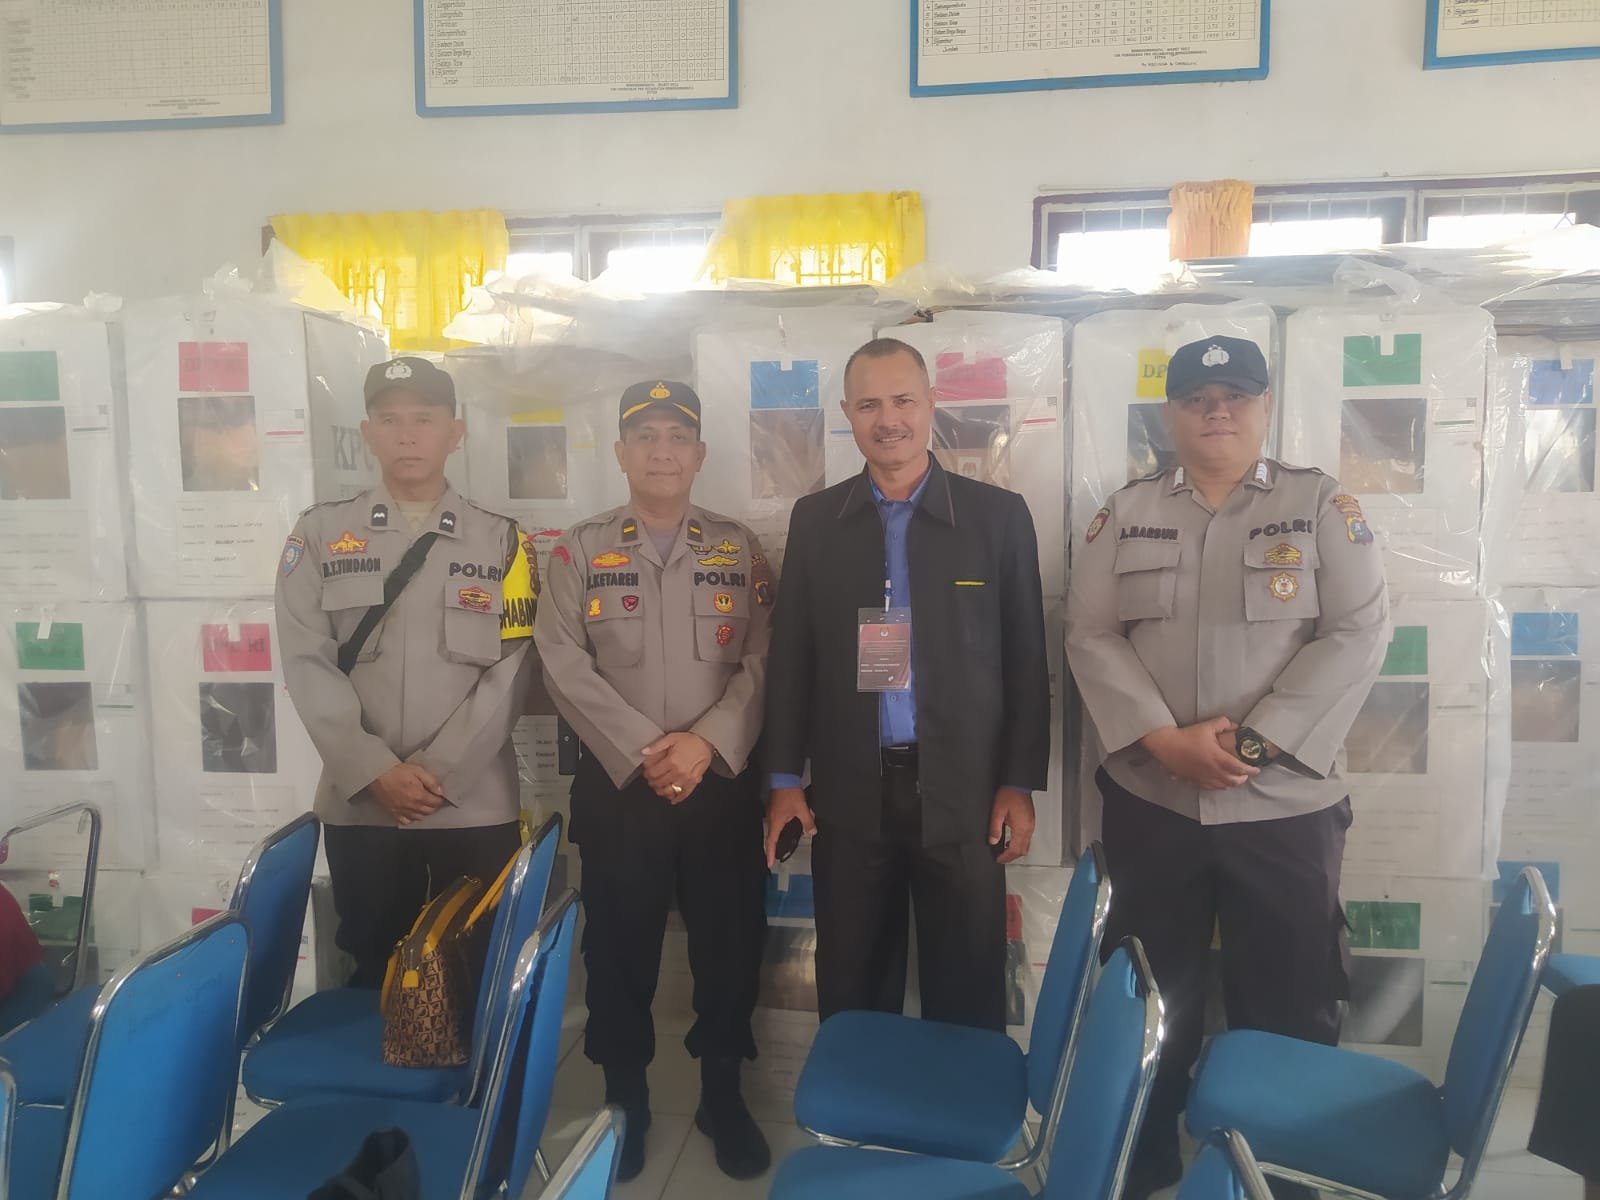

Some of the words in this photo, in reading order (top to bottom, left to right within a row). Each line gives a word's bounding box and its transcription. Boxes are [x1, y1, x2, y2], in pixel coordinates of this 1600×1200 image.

[1249, 519, 1312, 540] POLRI
[448, 562, 503, 582] POLRI
[694, 571, 745, 588] POLRI
